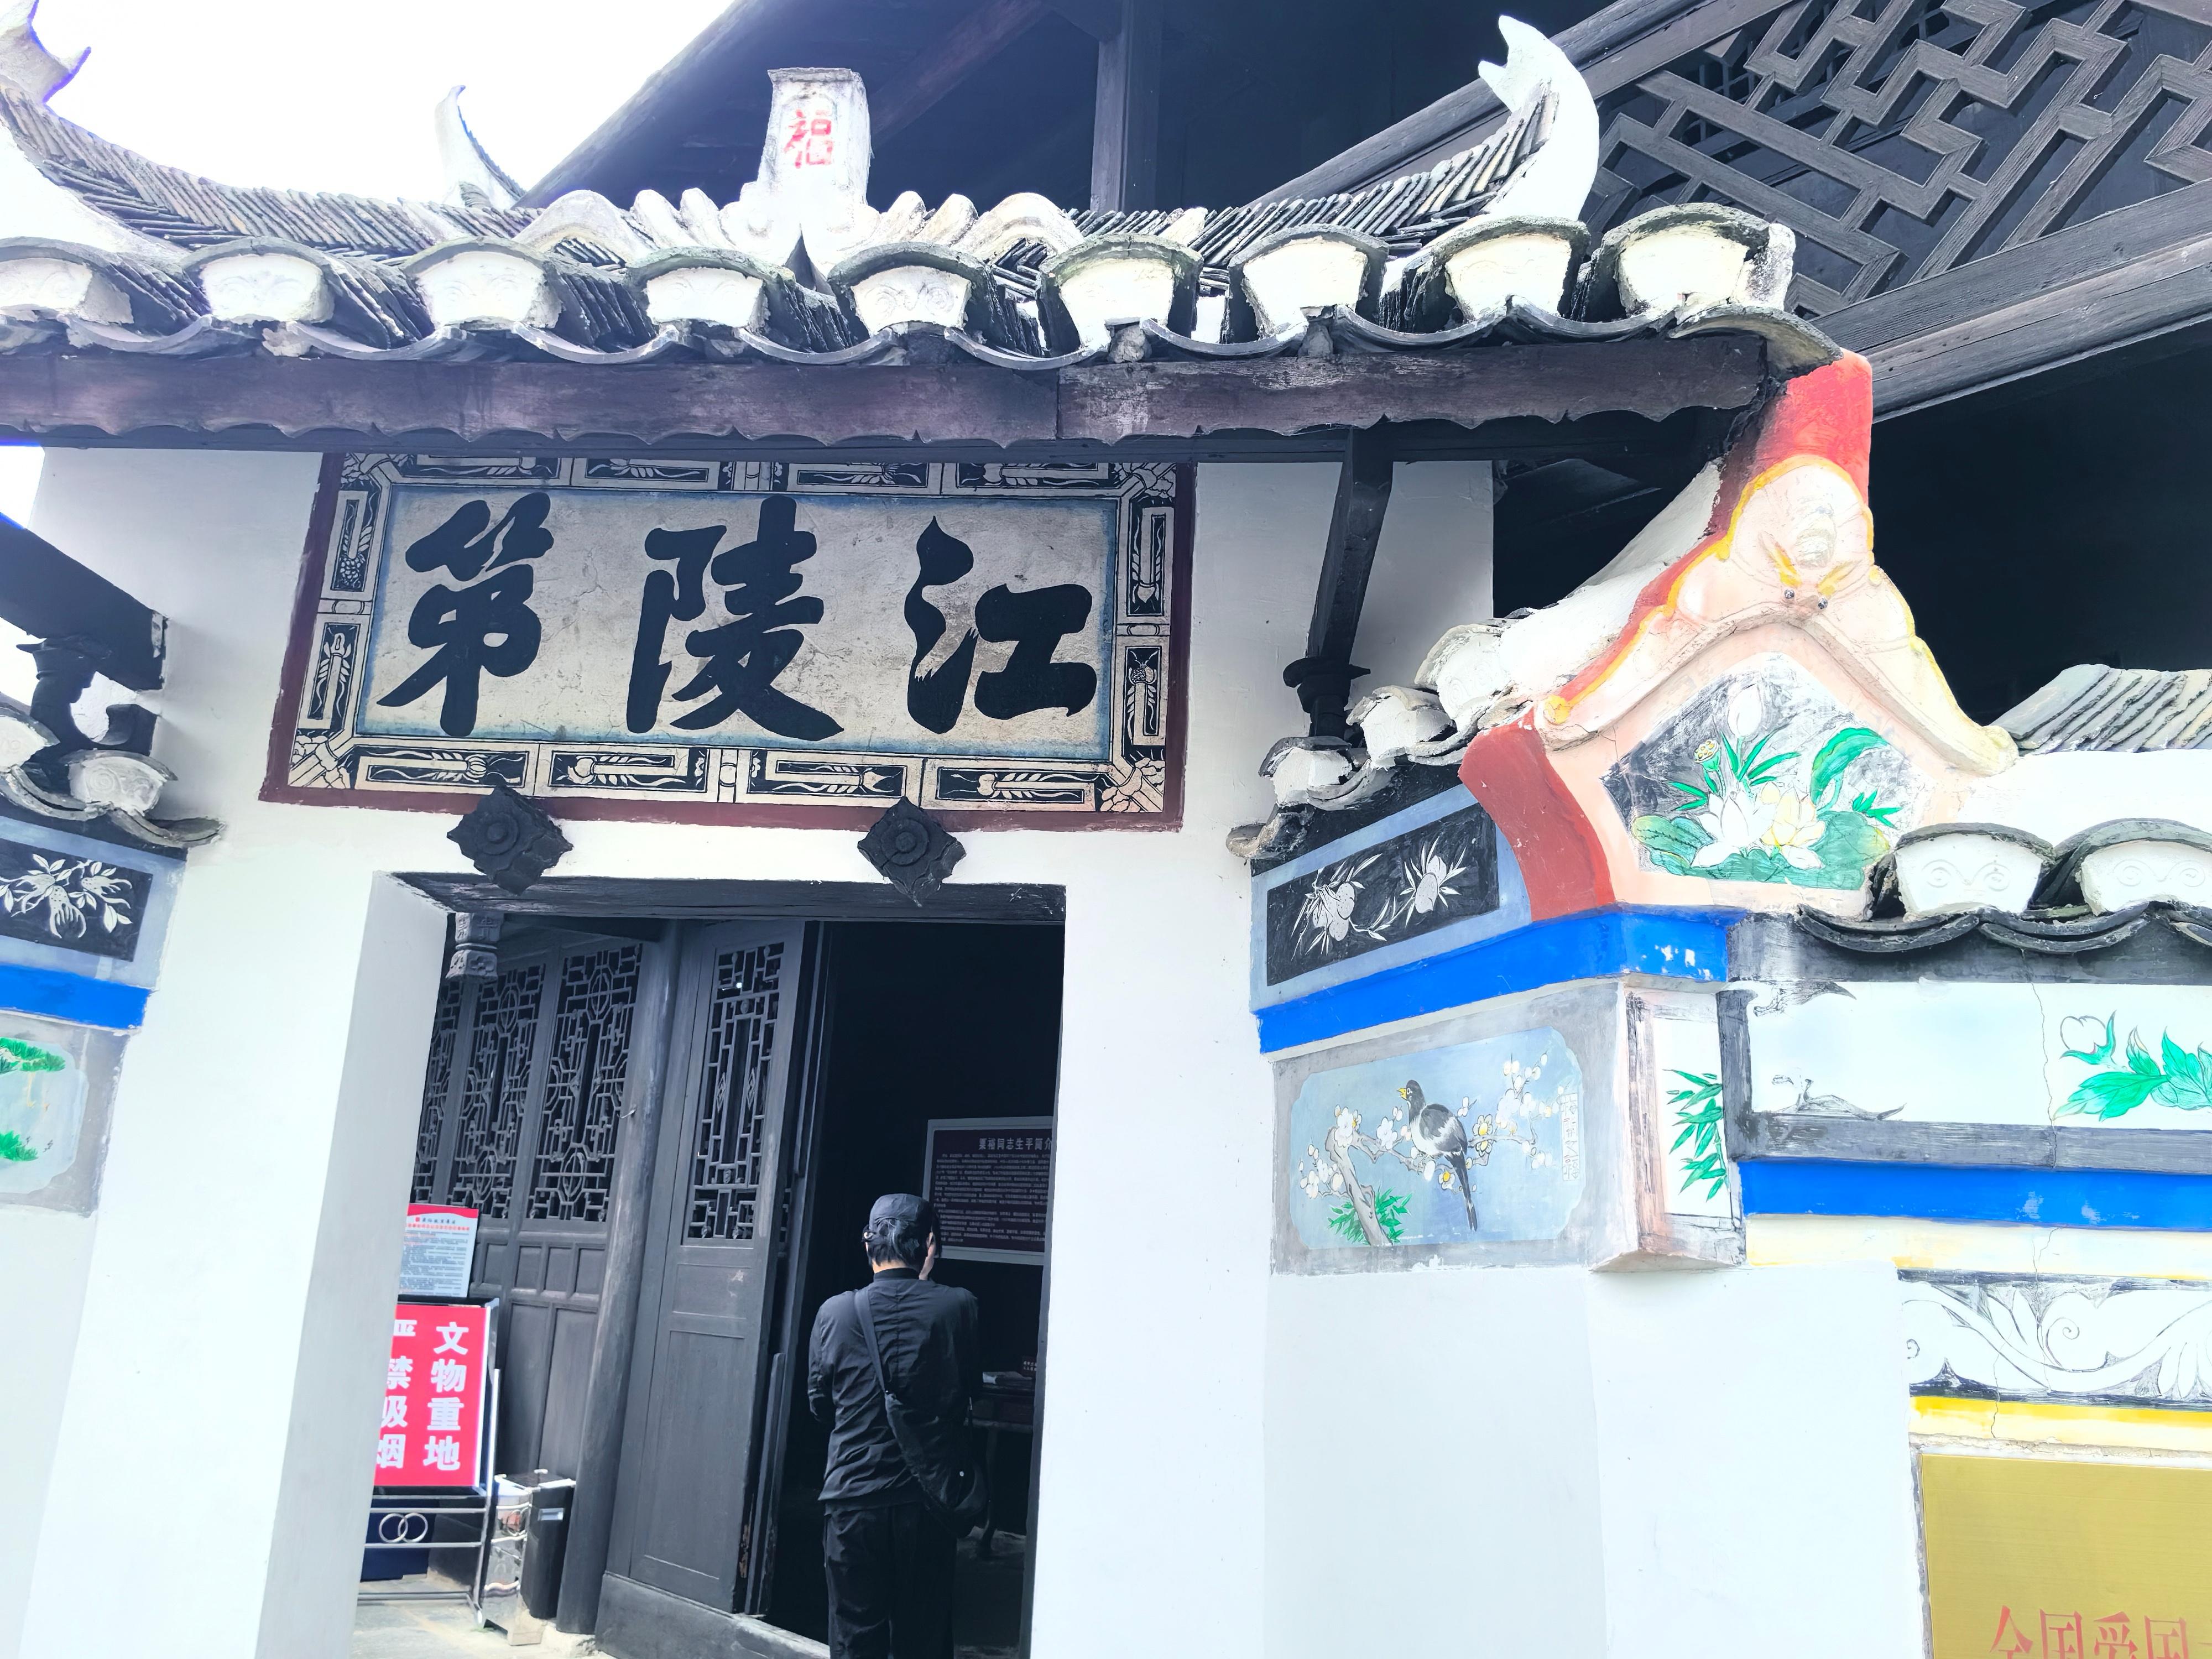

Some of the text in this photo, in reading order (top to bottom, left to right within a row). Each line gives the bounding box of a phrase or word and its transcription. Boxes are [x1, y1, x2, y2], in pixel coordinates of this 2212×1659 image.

[422, 1321, 469, 1471] 文物重地
[1989, 1605, 2212, 1659] 全国爱国
